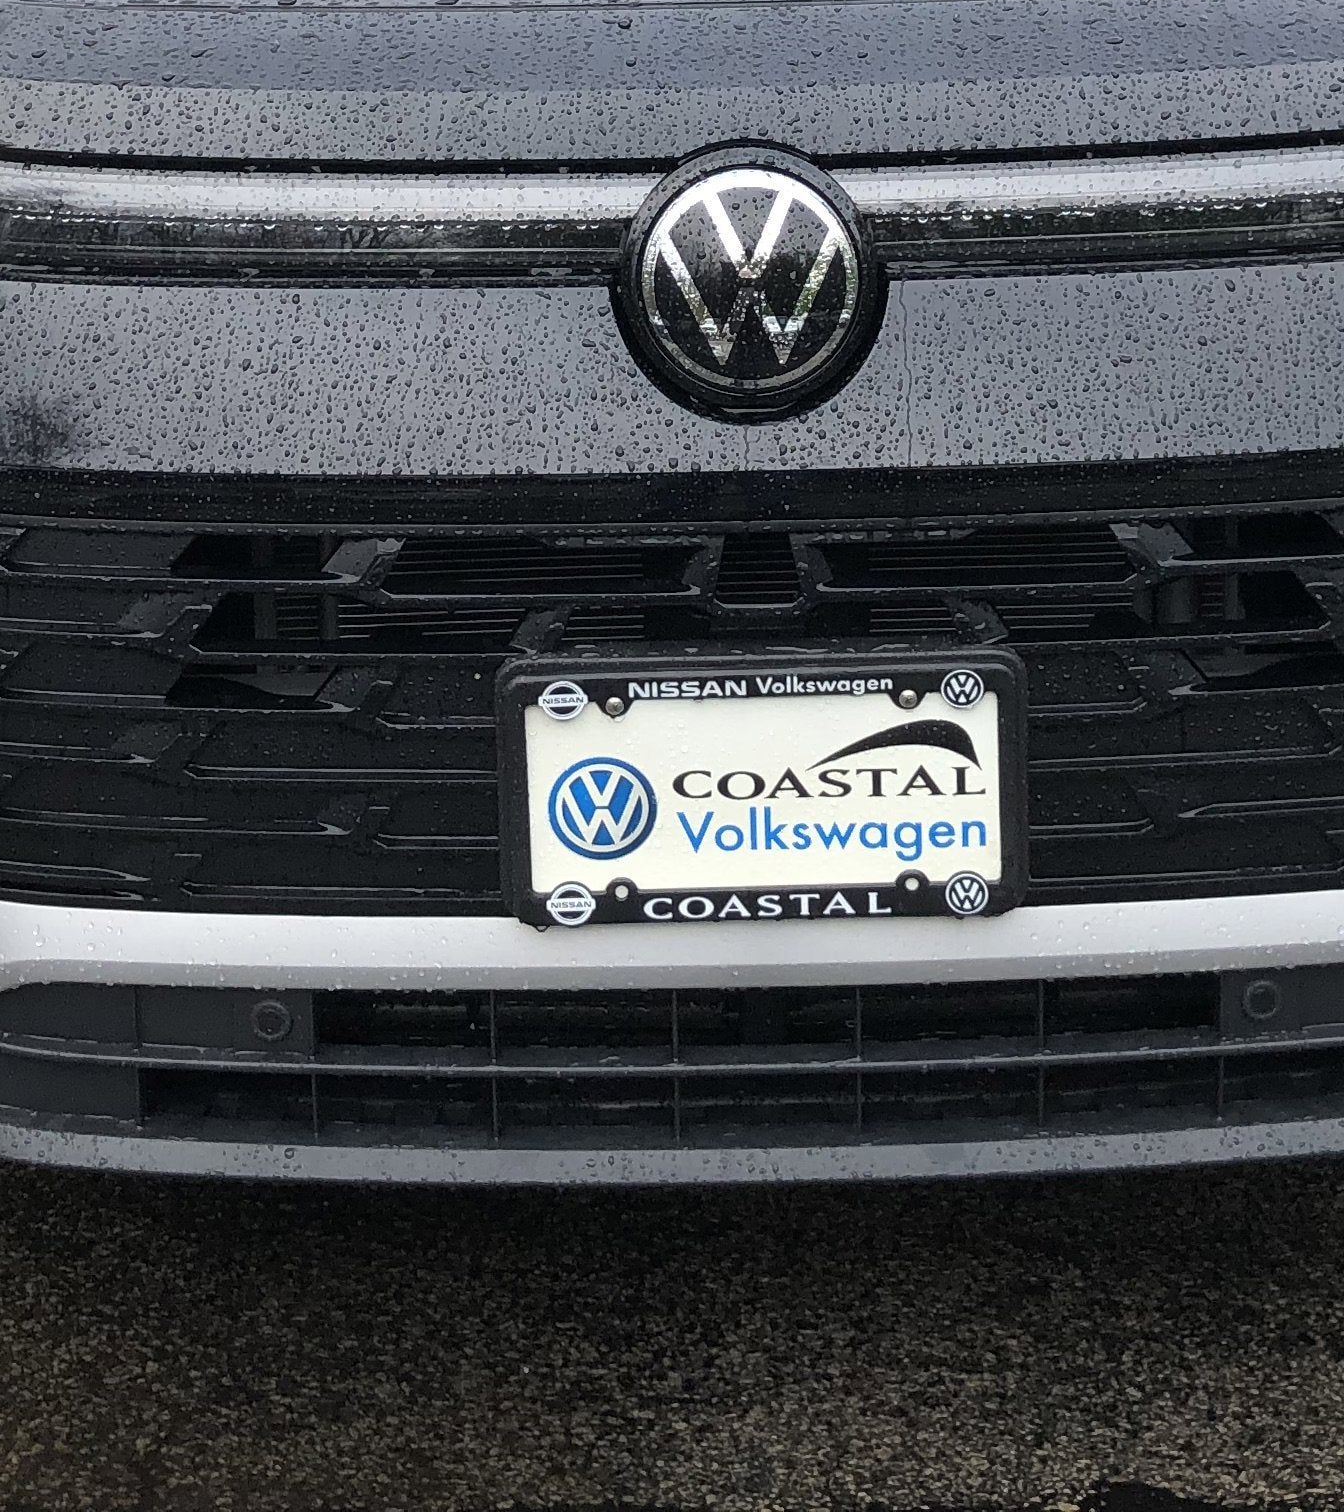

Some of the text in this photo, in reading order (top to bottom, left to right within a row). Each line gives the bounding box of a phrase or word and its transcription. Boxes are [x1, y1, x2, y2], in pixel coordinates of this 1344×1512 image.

[628, 675, 893, 699] NISSAN Volkswagen
[542, 696, 584, 705] NISSAN
[672, 765, 986, 799] COASTAL
[676, 806, 987, 861] Volkswagen
[550, 900, 592, 909] NISSAN
[642, 890, 892, 919] COASTAL
